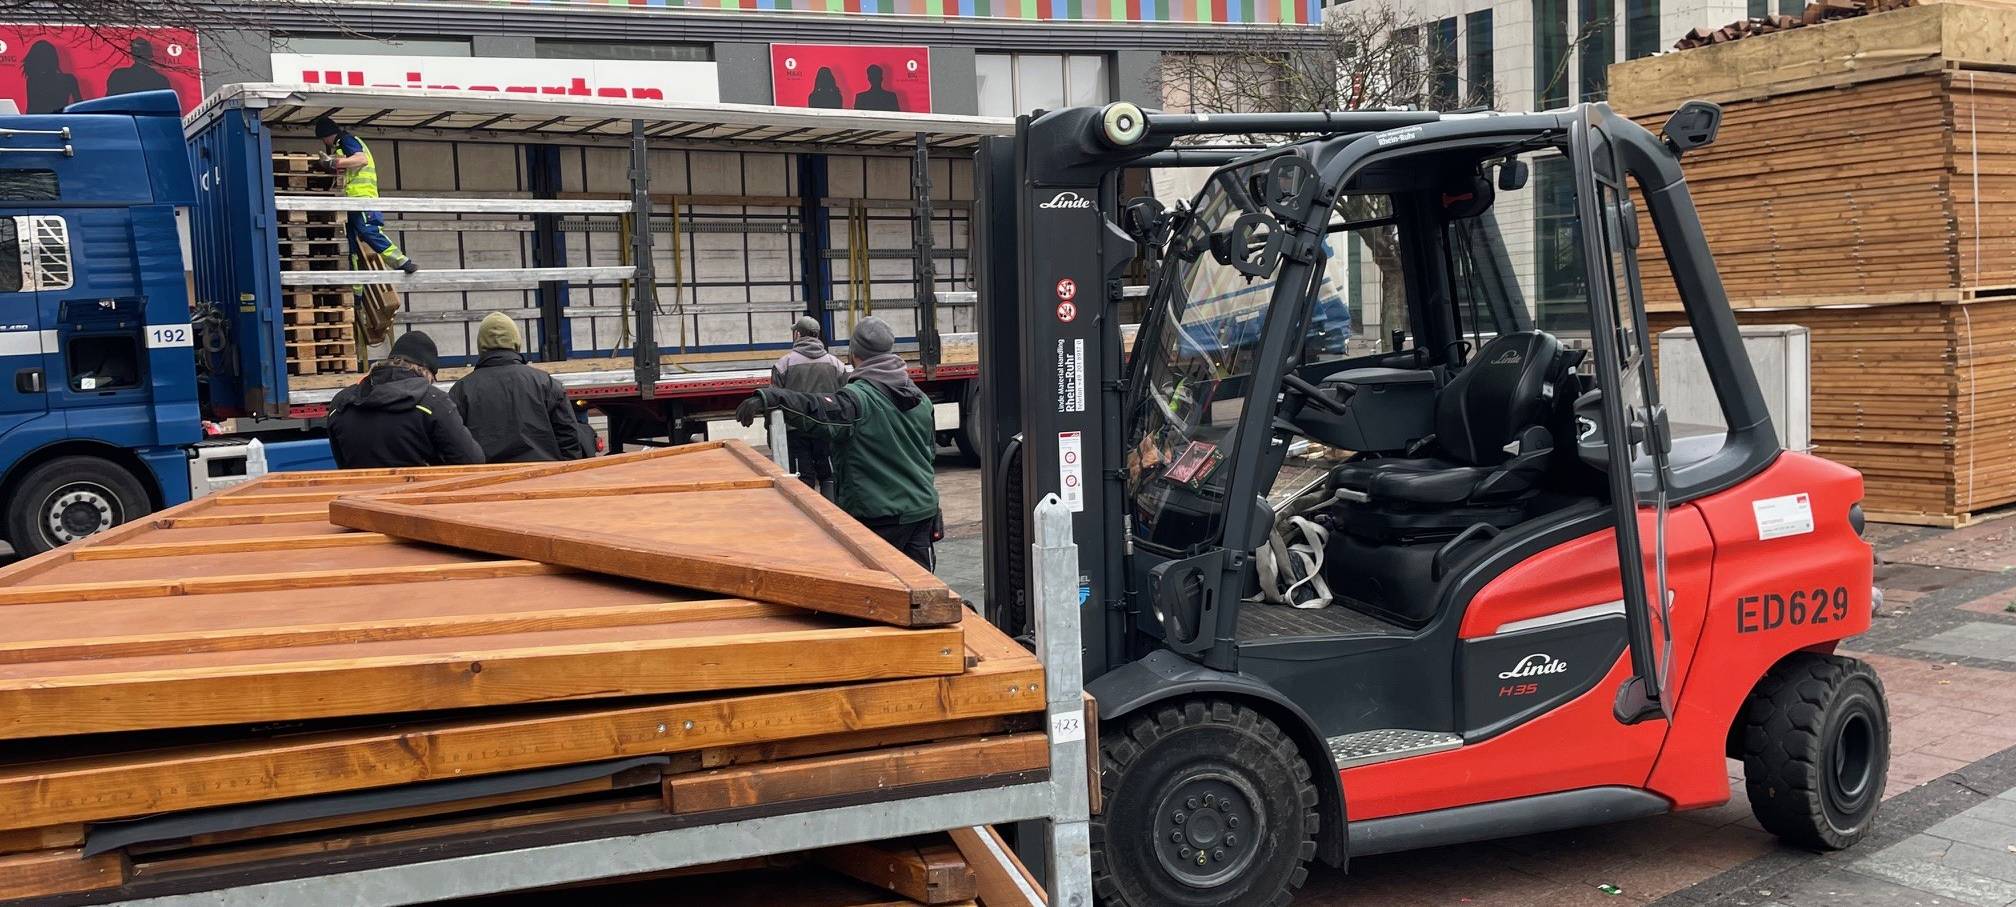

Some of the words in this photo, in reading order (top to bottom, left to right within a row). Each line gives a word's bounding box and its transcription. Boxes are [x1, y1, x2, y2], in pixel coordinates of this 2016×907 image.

[1039, 191, 1090, 209] Linde
[153, 329, 186, 343] 192
[1057, 339, 1065, 367] Handling
[1057, 368, 1065, 394] Material
[1065, 353, 1075, 412] Rhein-Ruhr
[1057, 395, 1065, 413] Linde
[1737, 586, 1848, 634] ED629
[1498, 653, 1568, 679] Linde
[1055, 718, 1079, 734] 123
